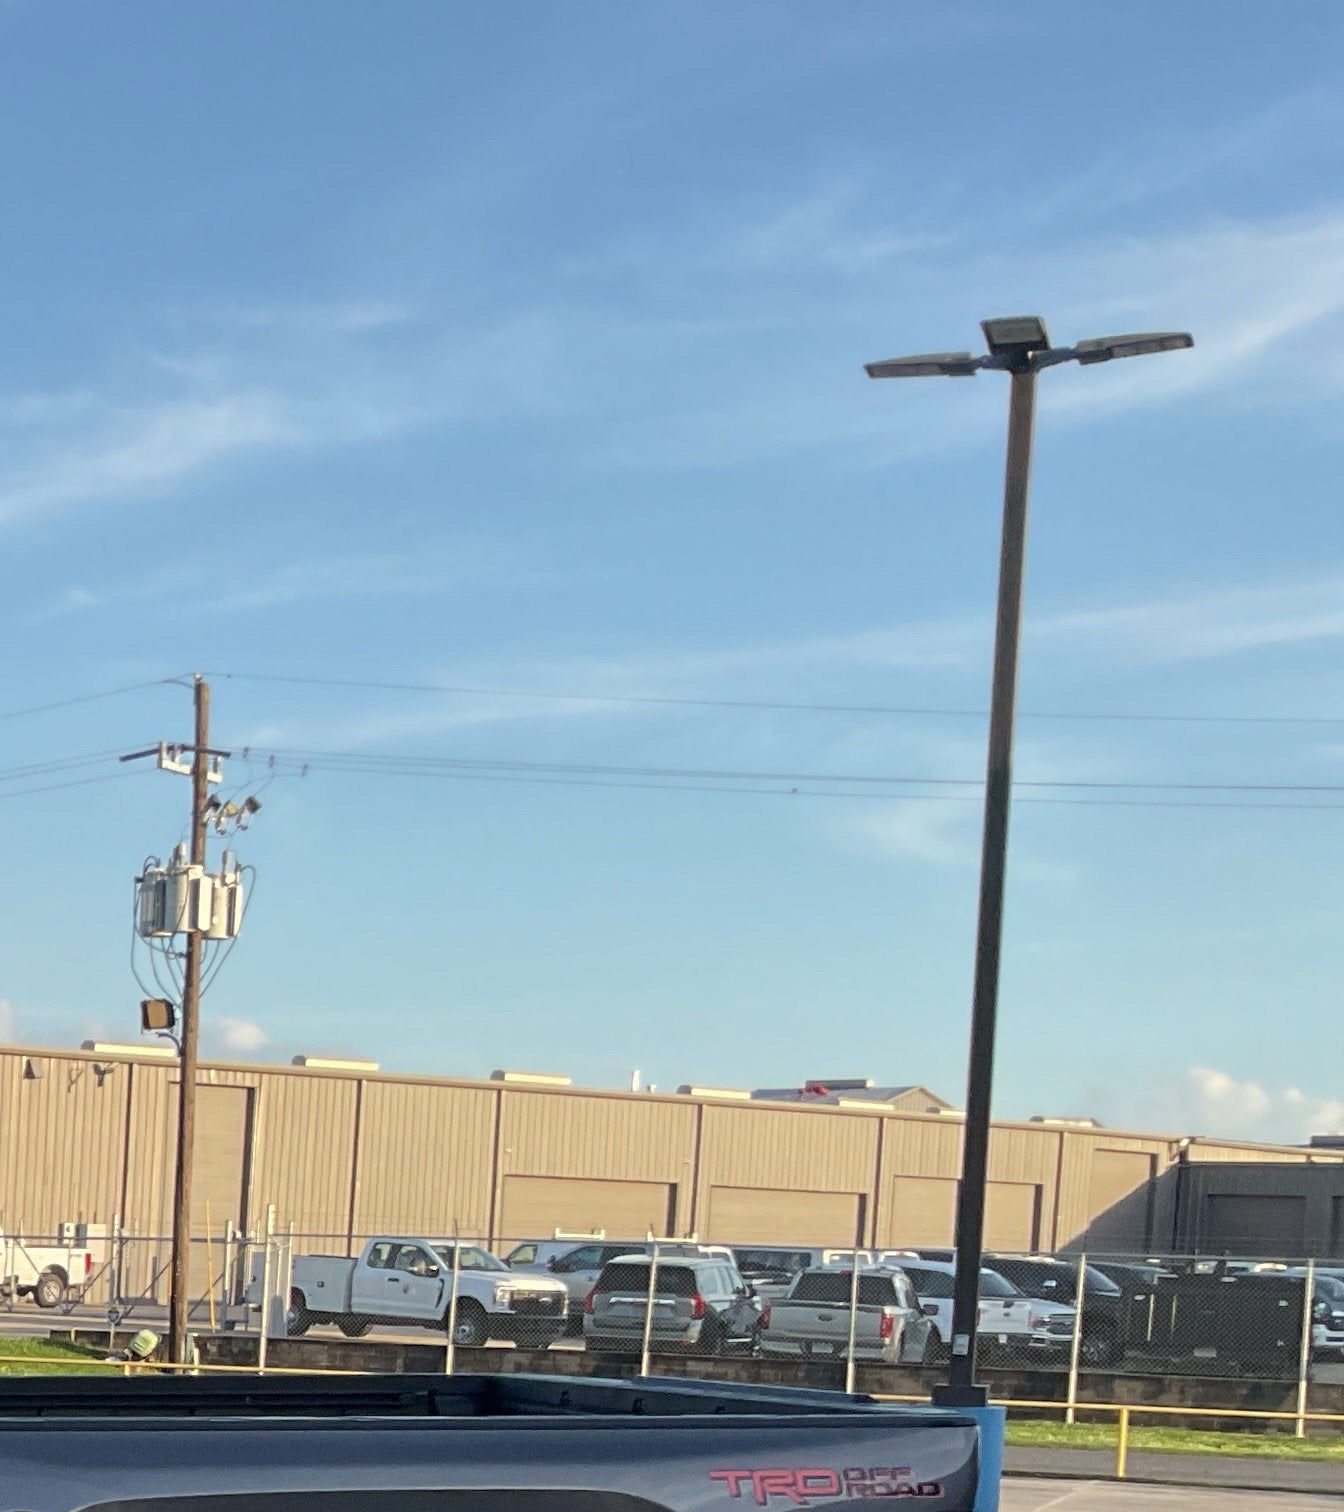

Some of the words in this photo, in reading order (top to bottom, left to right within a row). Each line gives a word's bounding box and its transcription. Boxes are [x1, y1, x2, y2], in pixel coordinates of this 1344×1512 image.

[708, 1466, 844, 1506] TRD
[843, 1467, 912, 1481] OFF
[846, 1481, 944, 1499] ROAD
